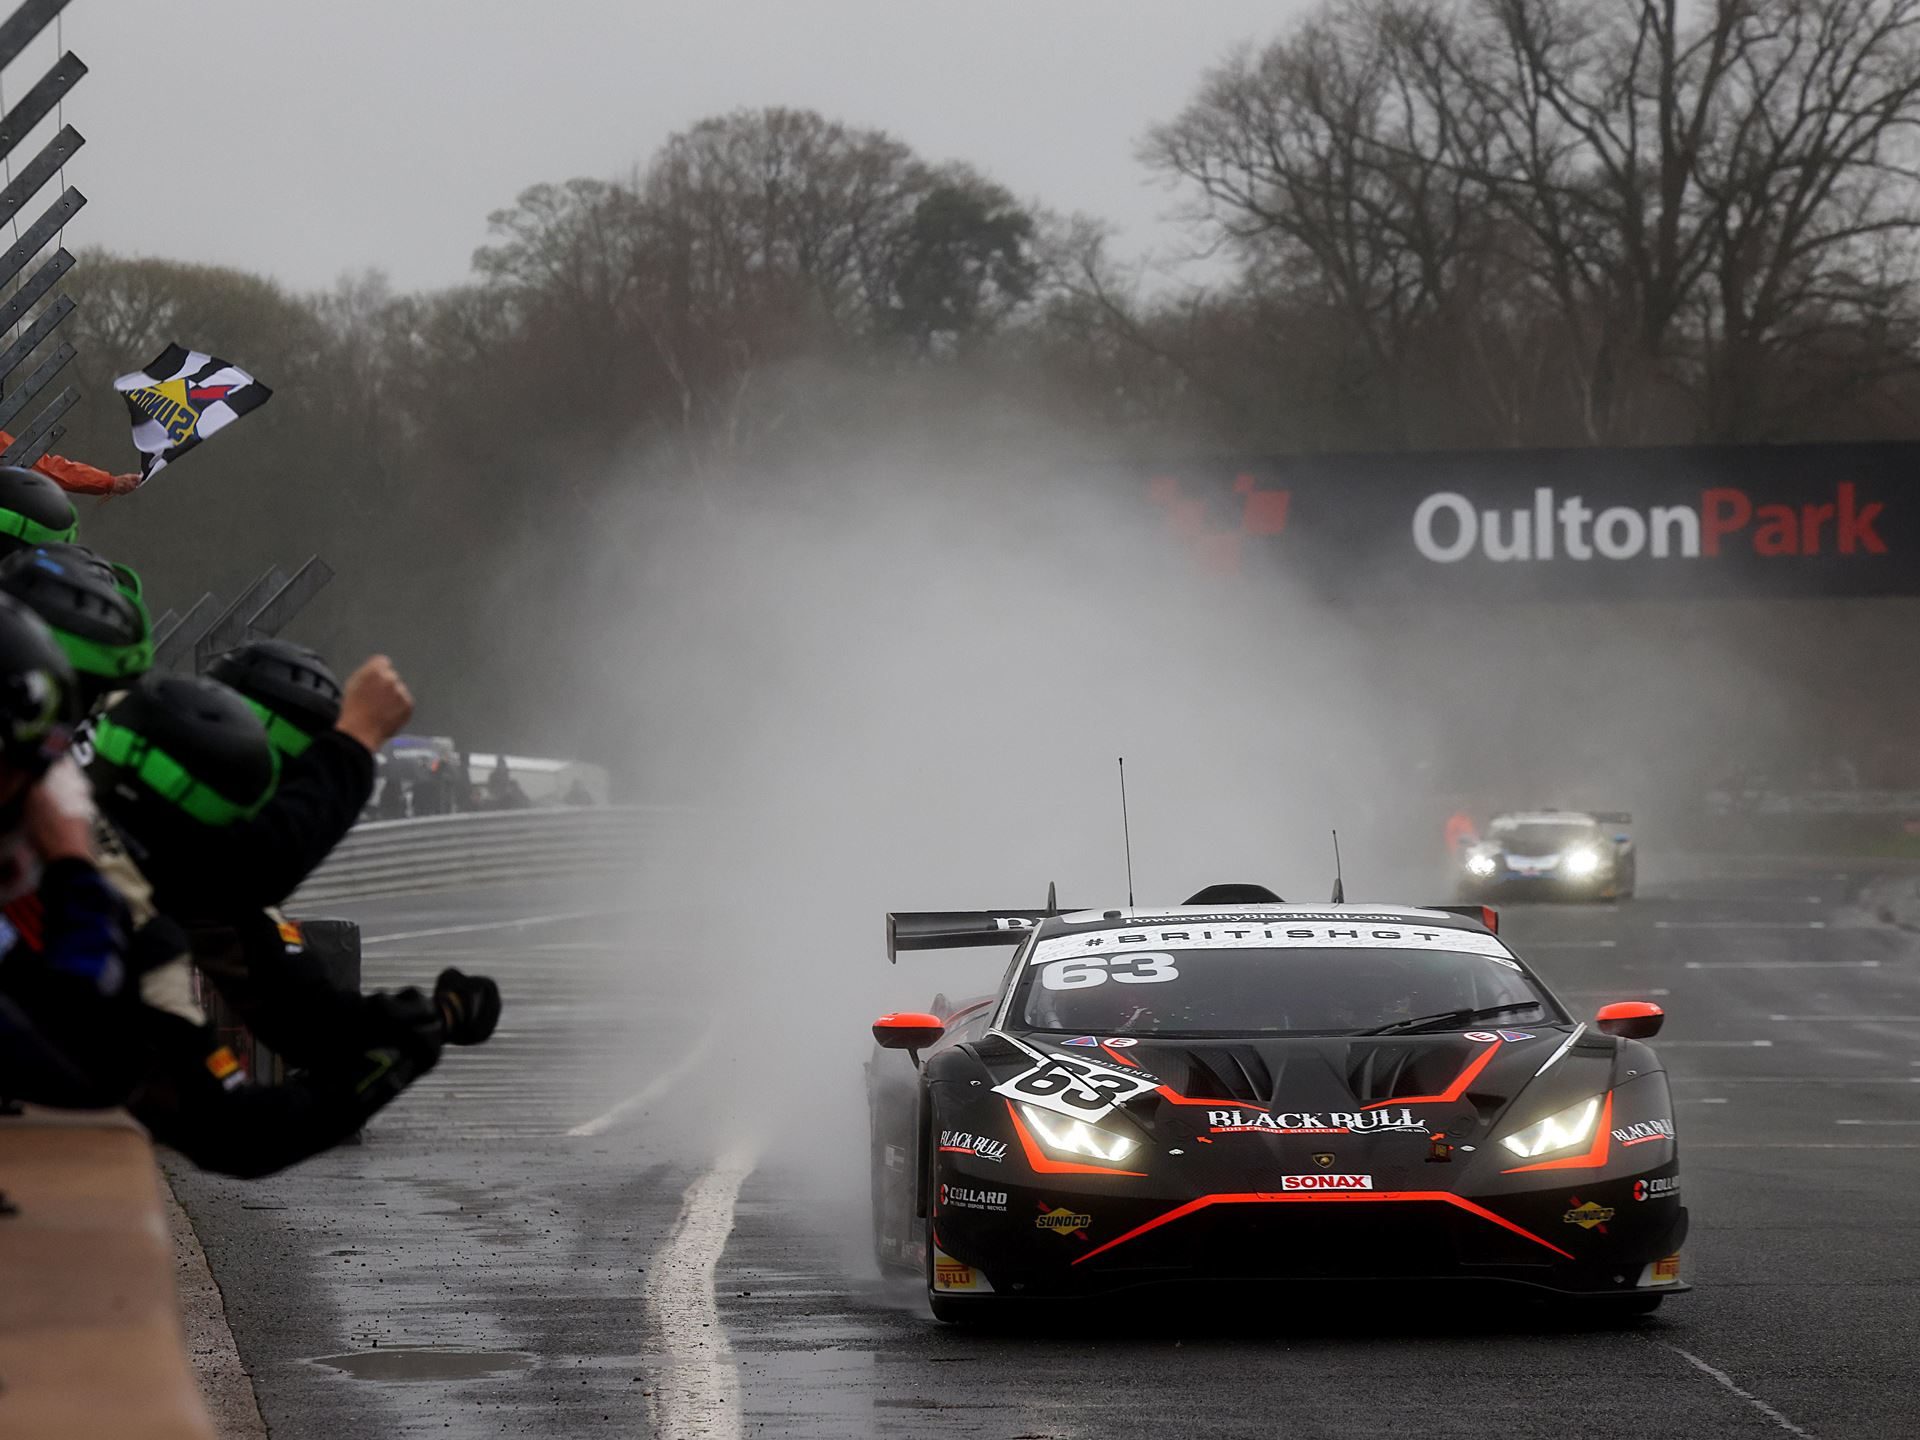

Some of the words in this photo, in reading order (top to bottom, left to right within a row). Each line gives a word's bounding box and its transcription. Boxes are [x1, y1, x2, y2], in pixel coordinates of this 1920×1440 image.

[1085, 928, 1440, 948] #BRITISHGT
[1042, 952, 1179, 991] 63
[1014, 1059, 1139, 1110] 63
[1207, 1110, 1328, 1129] BLACK
[1329, 1108, 1426, 1130] BULL
[1611, 1123, 1658, 1141] BLACK
[940, 1130, 972, 1148] BLACK
[972, 1136, 1008, 1158] BULL
[1284, 1176, 1365, 1189] SONAX
[950, 1187, 1008, 1205] COLLARD
[1038, 1215, 1090, 1227] SUNOCO
